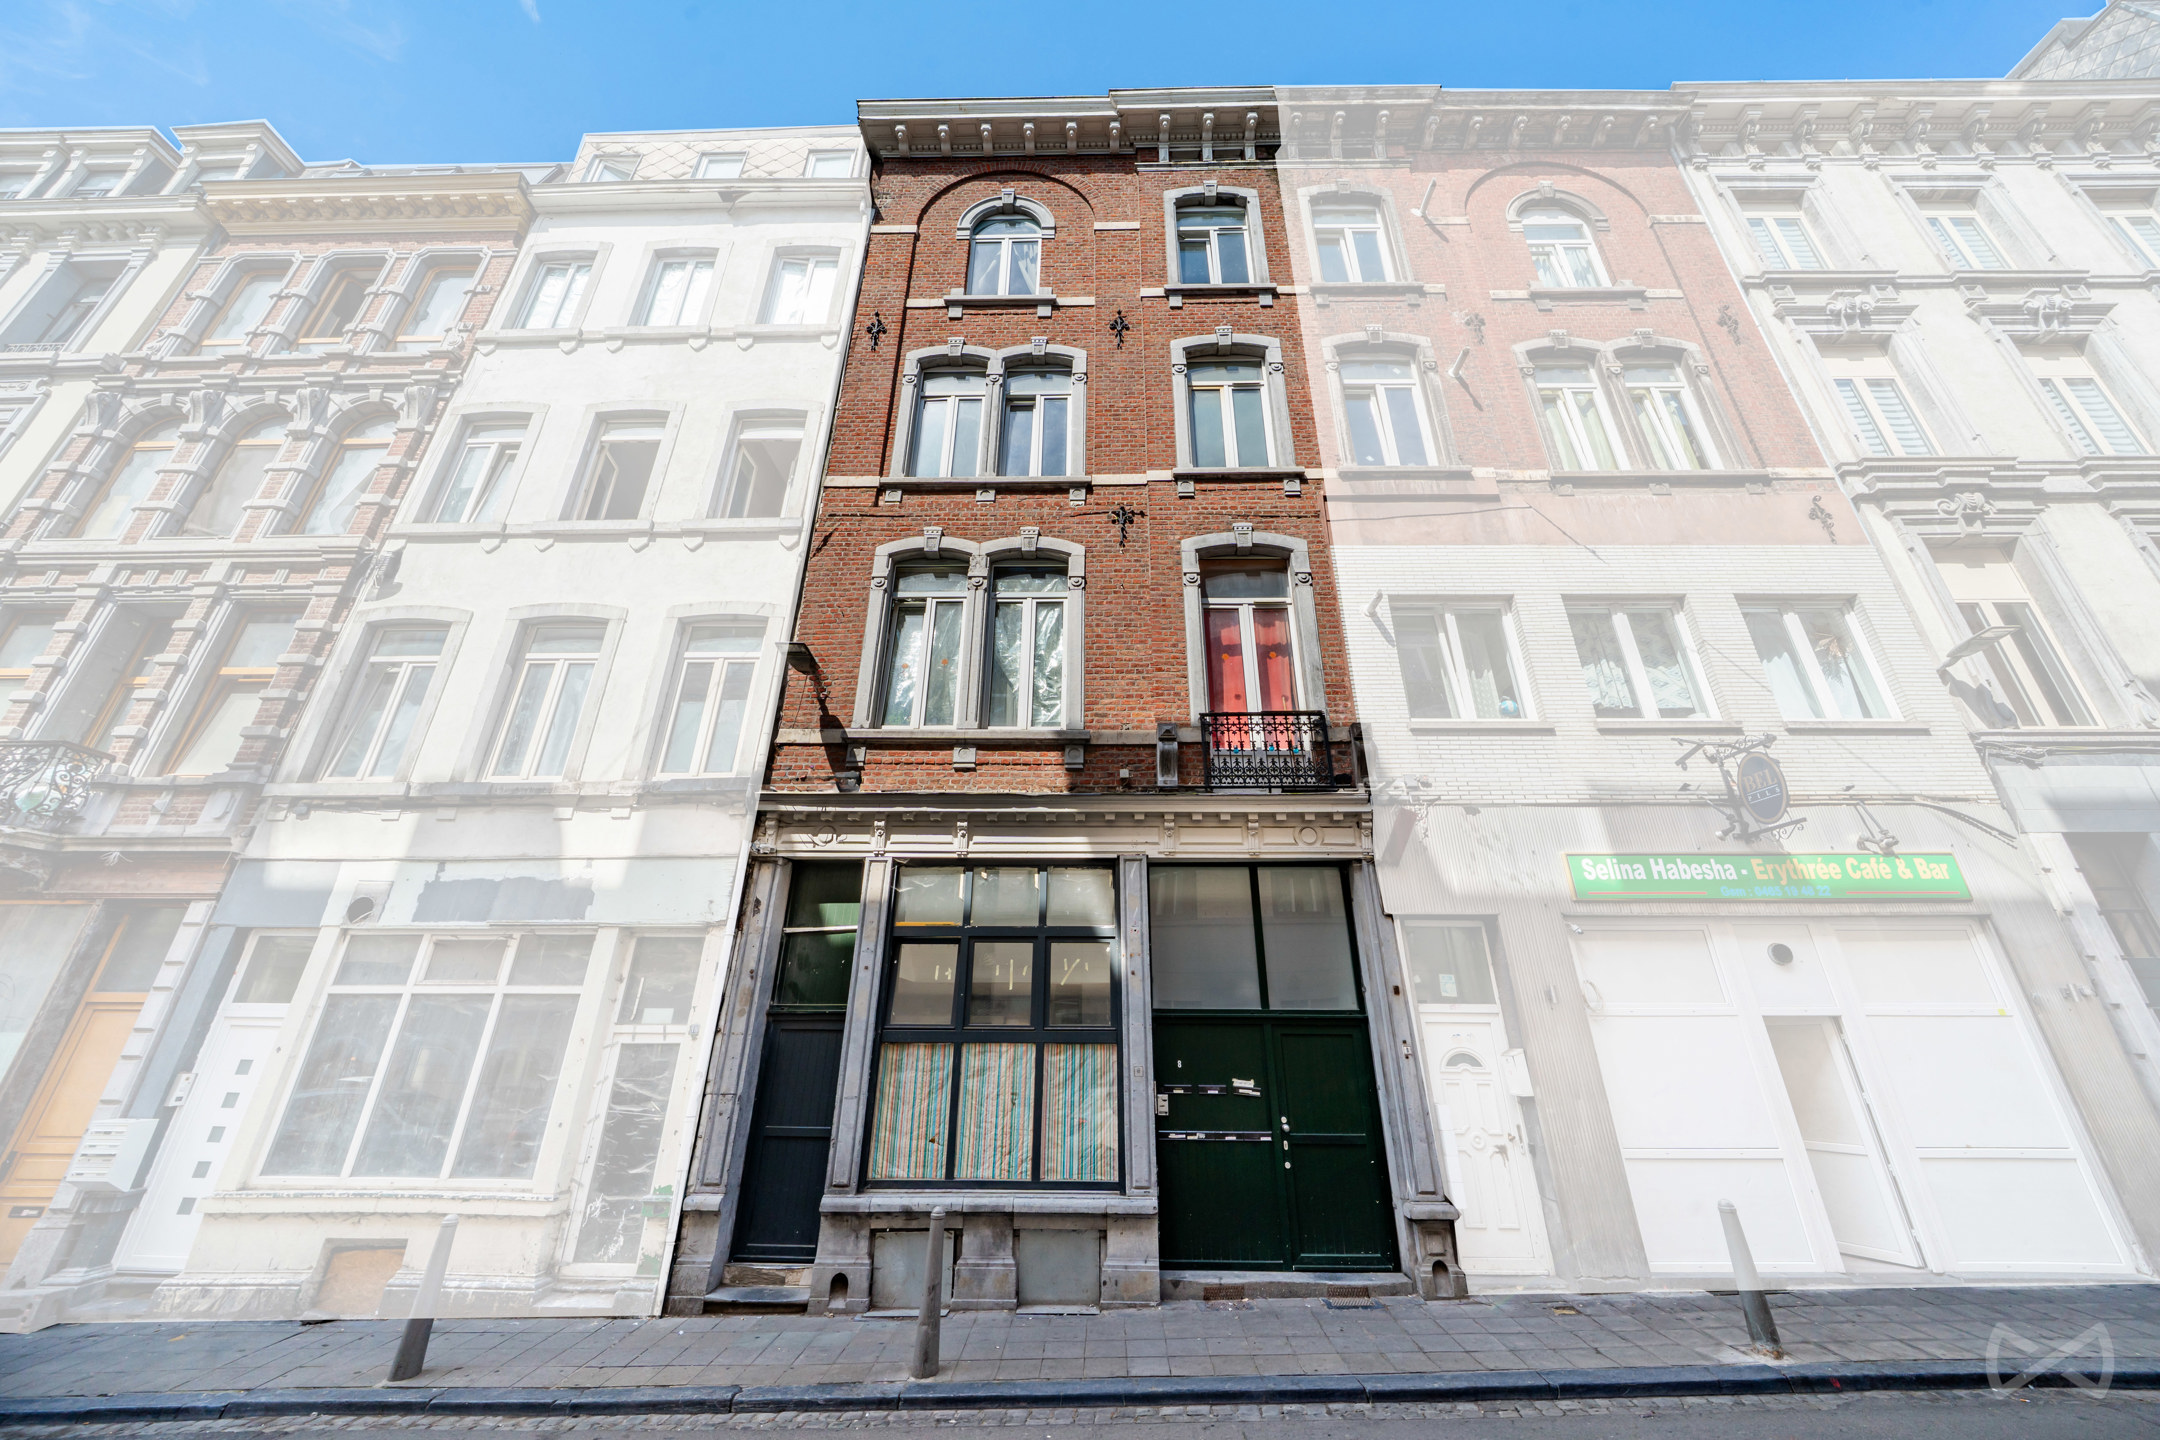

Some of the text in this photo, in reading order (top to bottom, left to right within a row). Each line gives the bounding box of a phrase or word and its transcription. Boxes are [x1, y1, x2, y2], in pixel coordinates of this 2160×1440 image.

[1744, 769, 1777, 792] BEL
[1748, 787, 1780, 802] PILS
[1581, 858, 1646, 880] Selina
[1649, 858, 1738, 880] Habesha
[1751, 857, 1842, 885] Erythrée
[1845, 857, 1892, 880] Café
[1895, 858, 1914, 880] &
[1913, 858, 1950, 880] Bar
[1816, 885, 1831, 897] 22
[1177, 1060, 1182, 1068] 8
